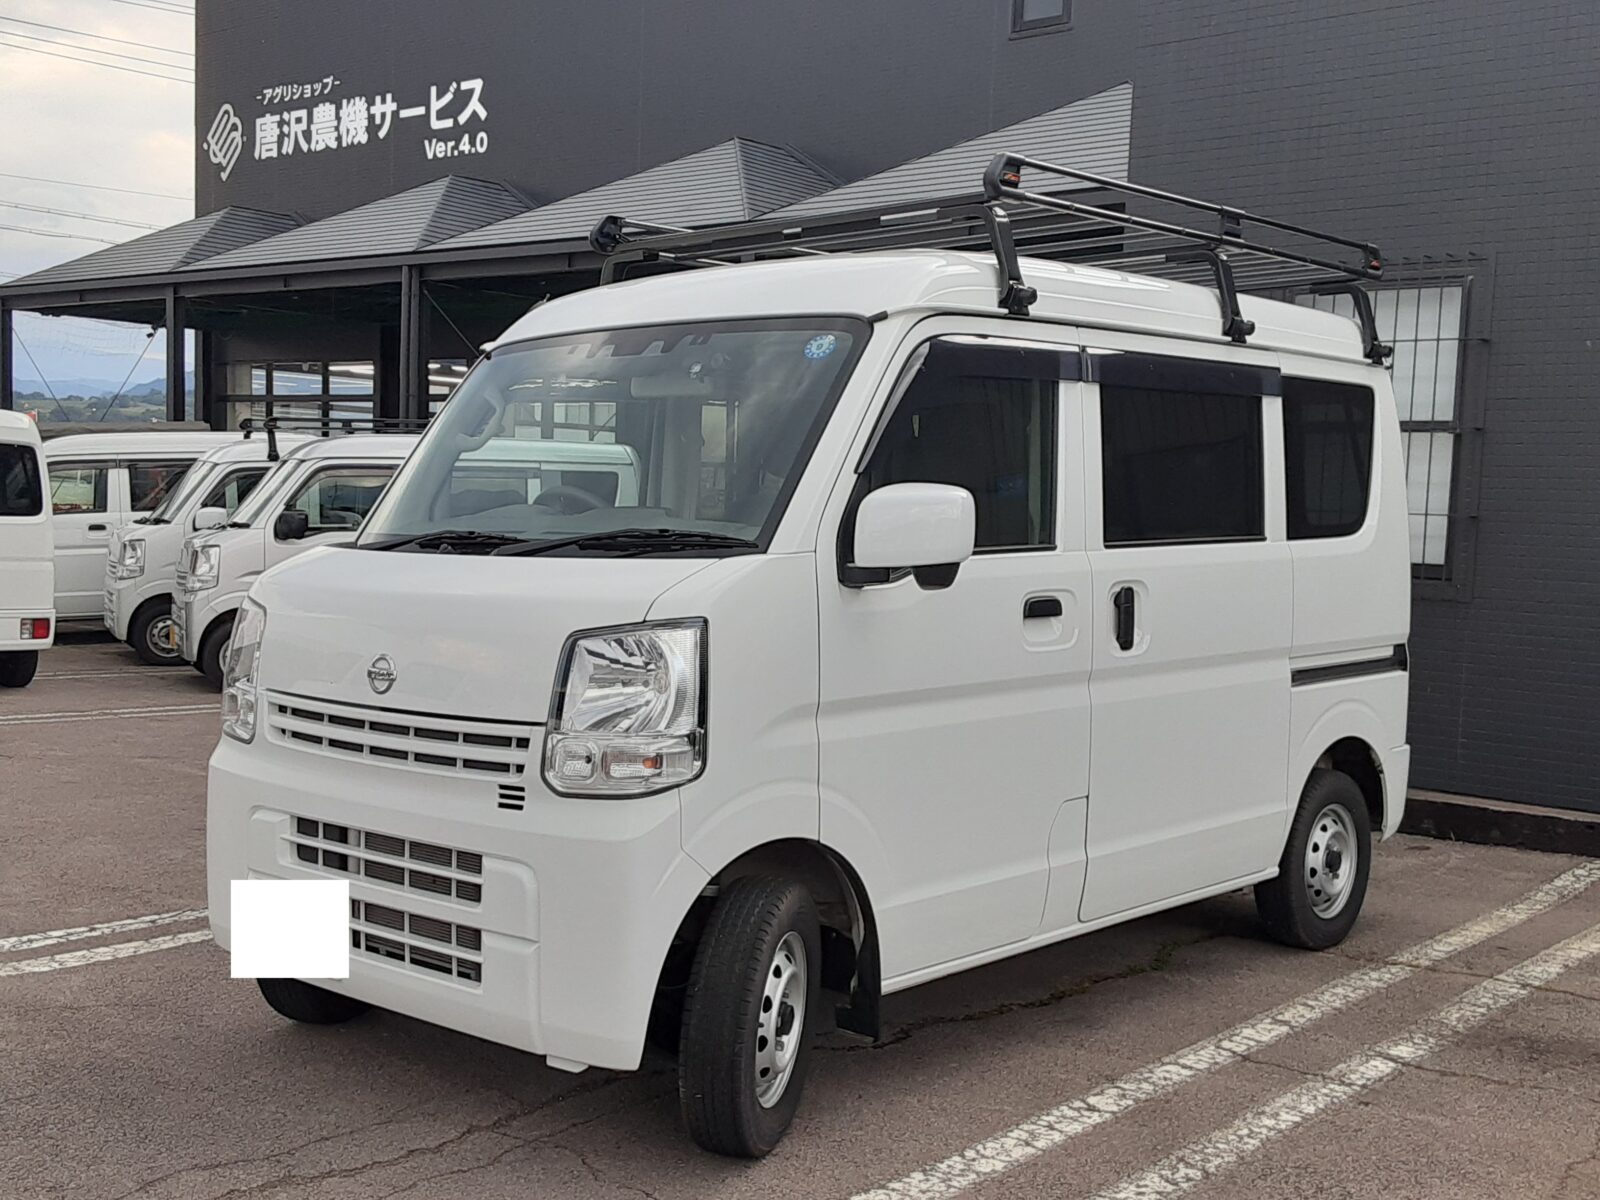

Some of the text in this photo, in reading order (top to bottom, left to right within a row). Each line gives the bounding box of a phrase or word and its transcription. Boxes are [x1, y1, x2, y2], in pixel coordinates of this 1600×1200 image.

[254, 78, 488, 160] 唐沢農機サービス
[424, 131, 488, 160] Ver.4.0
